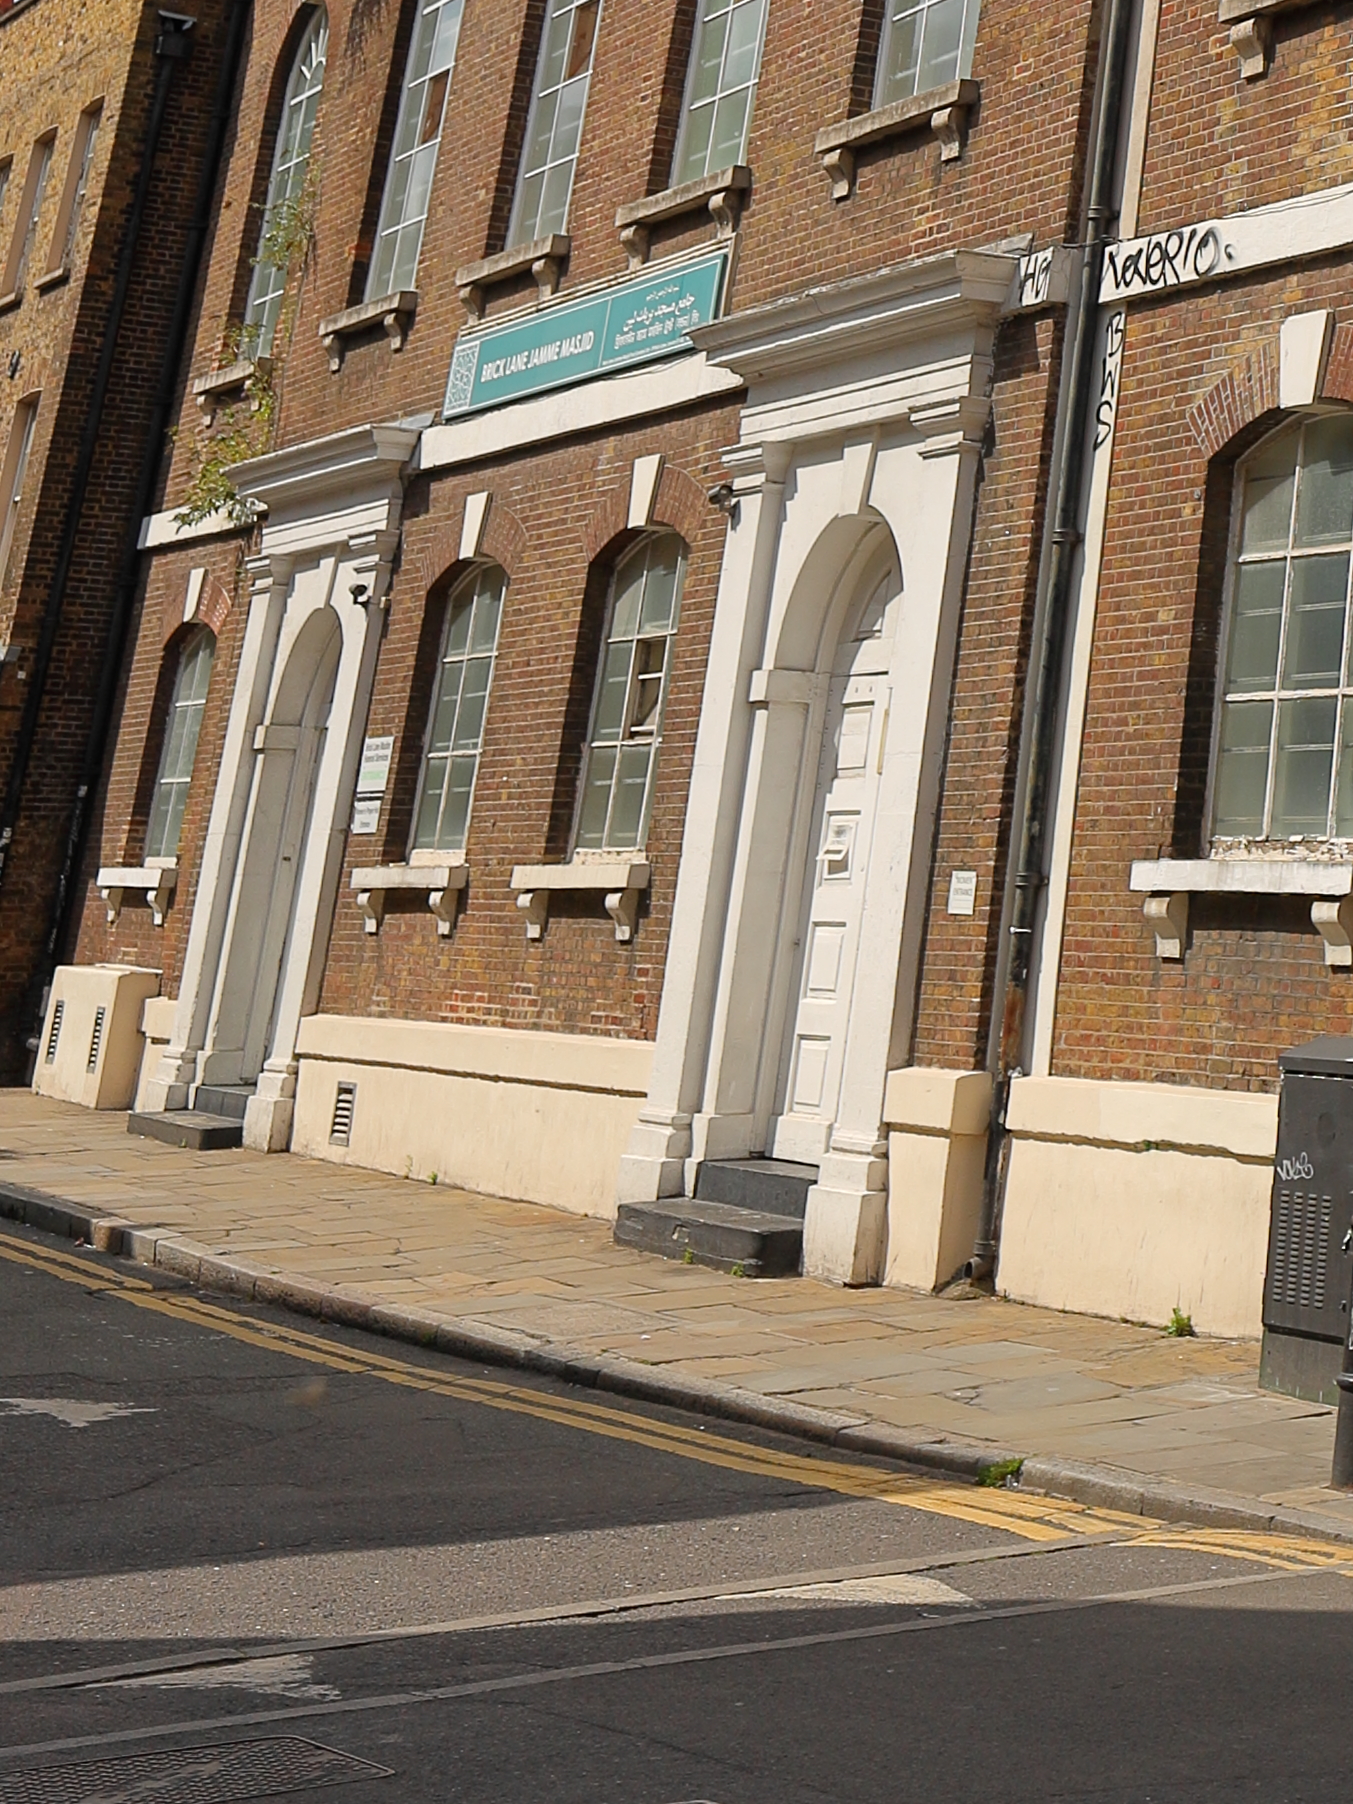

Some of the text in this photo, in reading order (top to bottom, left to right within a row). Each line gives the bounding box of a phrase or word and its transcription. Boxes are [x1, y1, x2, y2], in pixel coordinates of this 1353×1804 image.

[480, 357, 507, 383] BRICK
[505, 348, 528, 376] LANE
[526, 340, 561, 370] JAMME
[559, 330, 595, 359] MASJID
